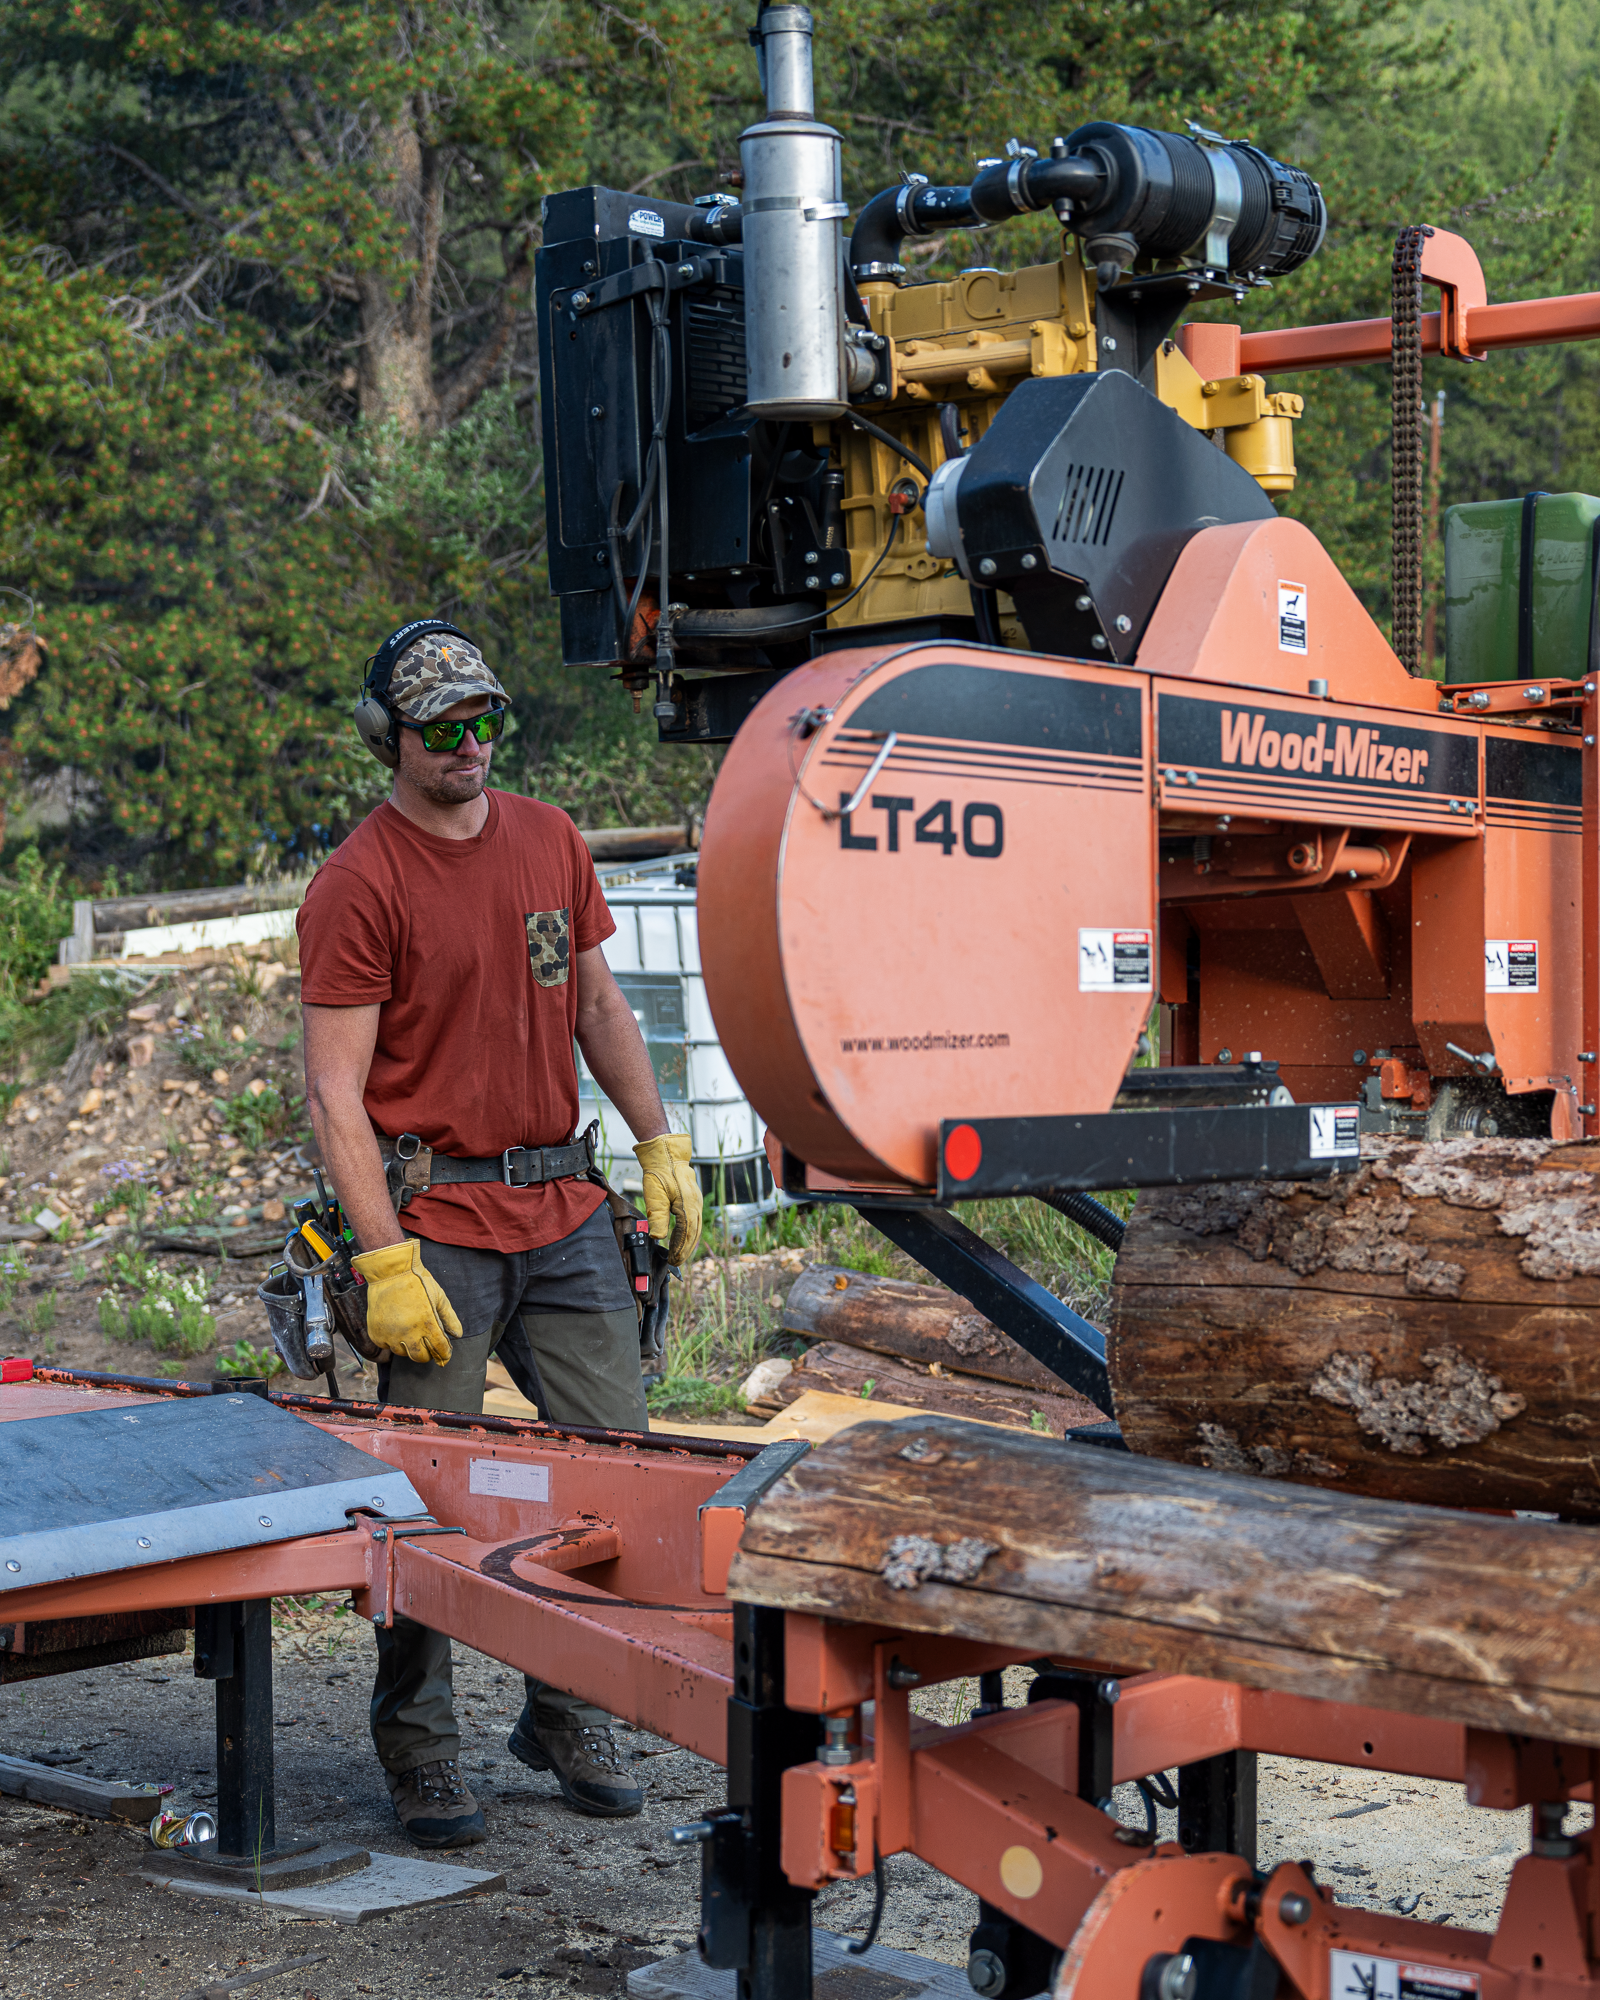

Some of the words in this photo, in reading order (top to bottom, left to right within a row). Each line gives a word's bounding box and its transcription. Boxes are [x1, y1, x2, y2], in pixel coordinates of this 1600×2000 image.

[639, 211, 662, 223] POWER
[389, 619, 444, 648] WALKER'S
[1221, 709, 1429, 784] Wood-Mizer
[840, 792, 1004, 858] LT40
[840, 1030, 1010, 1052] www.woodmizer.com
[1413, 1966, 1472, 1986] DANGER
